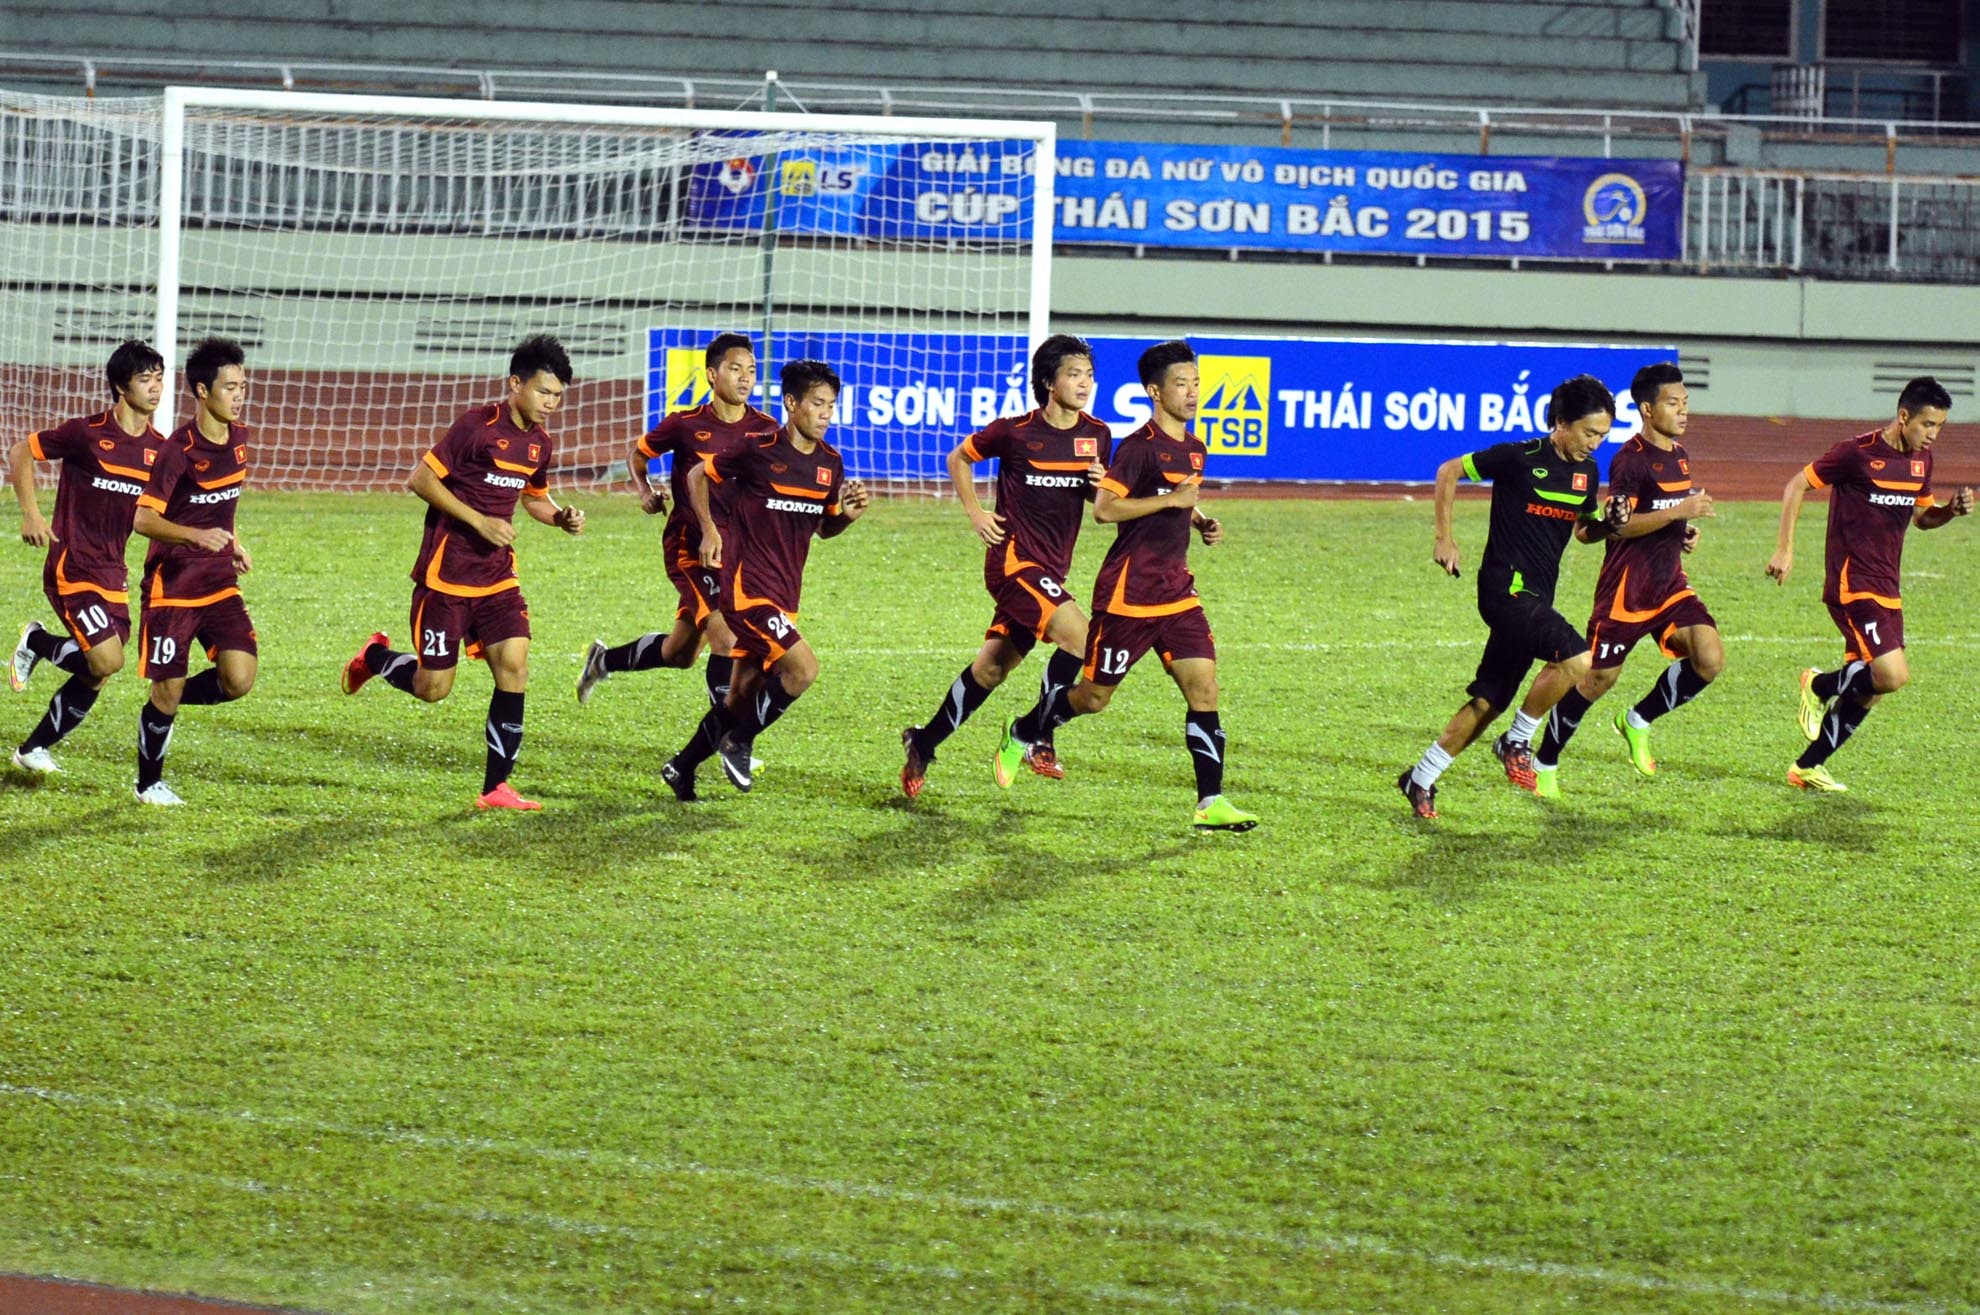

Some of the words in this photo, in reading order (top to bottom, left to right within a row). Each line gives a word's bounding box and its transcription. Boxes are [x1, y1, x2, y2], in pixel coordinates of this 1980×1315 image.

[1104, 155, 1151, 179] ĐÁ
[1161, 157, 1214, 181] NỮ
[1220, 159, 1264, 183] VÔ
[1274, 164, 1356, 189] ĐỊCH
[1366, 163, 1459, 190] QUỐC
[1469, 170, 1528, 192] GIA
[917, 187, 1019, 224] CÚP
[1164, 198, 1271, 234] SƠN
[1287, 194, 1389, 238] BẮC
[1405, 208, 1531, 242] 2015
[867, 381, 955, 427] SƠN
[970, 362, 1027, 426] BẮ
[1278, 381, 1372, 430] THÁI
[1384, 386, 1466, 431] SƠN
[1479, 369, 1555, 433] BẮC
[1200, 416, 1263, 448] TSB
[92, 477, 145, 496] HOND
[484, 472, 526, 489] HOND
[1025, 474, 1084, 487] HOND
[189, 486, 242, 504] HOND
[1869, 493, 1916, 506] HOND
[1526, 502, 1577, 521] HOND
[1040, 577, 1062, 597] 8
[77, 604, 109, 636] 10
[768, 611, 796, 639] 24
[424, 629, 449, 656] 21
[1864, 622, 1881, 645] 7
[150, 636, 176, 665] 19
[1100, 648, 1130, 674] 12
